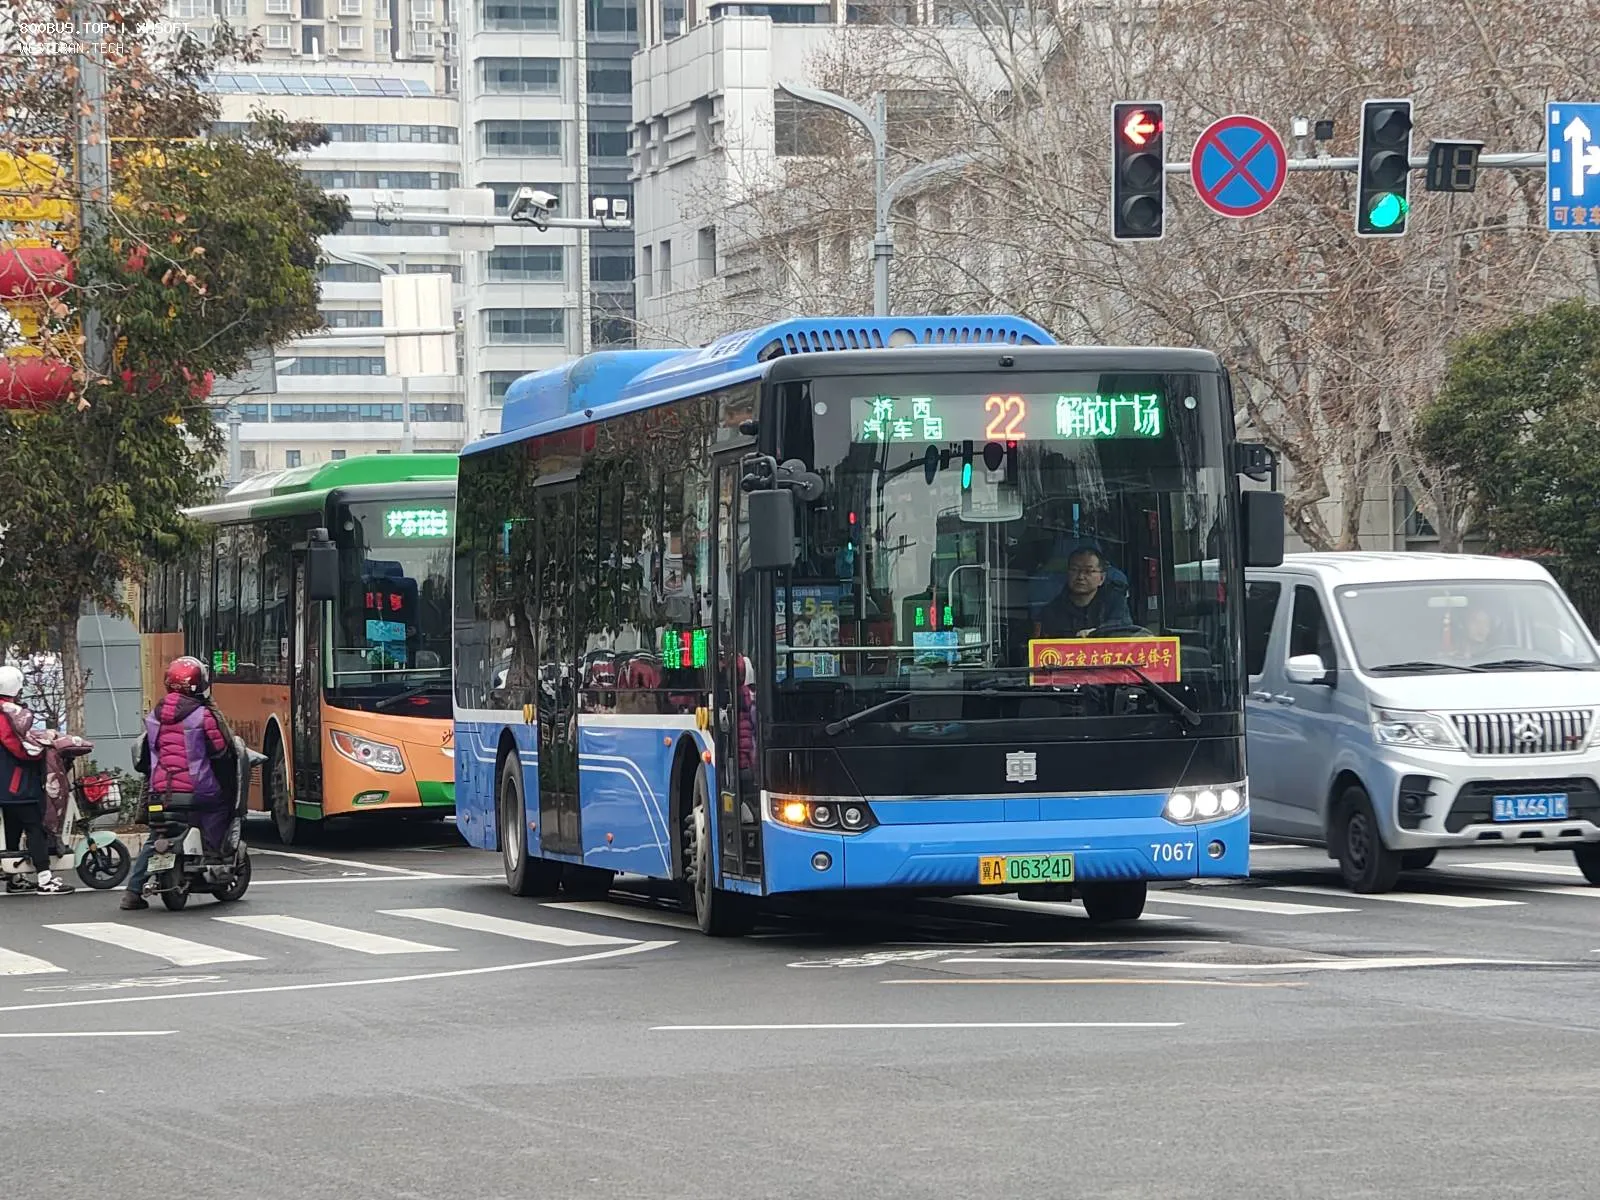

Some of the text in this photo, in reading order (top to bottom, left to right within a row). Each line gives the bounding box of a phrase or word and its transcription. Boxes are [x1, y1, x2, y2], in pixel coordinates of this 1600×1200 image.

[984, 395, 1026, 440] 22
[1055, 393, 1161, 438] 解放广场
[1150, 842, 1195, 862] 7067
